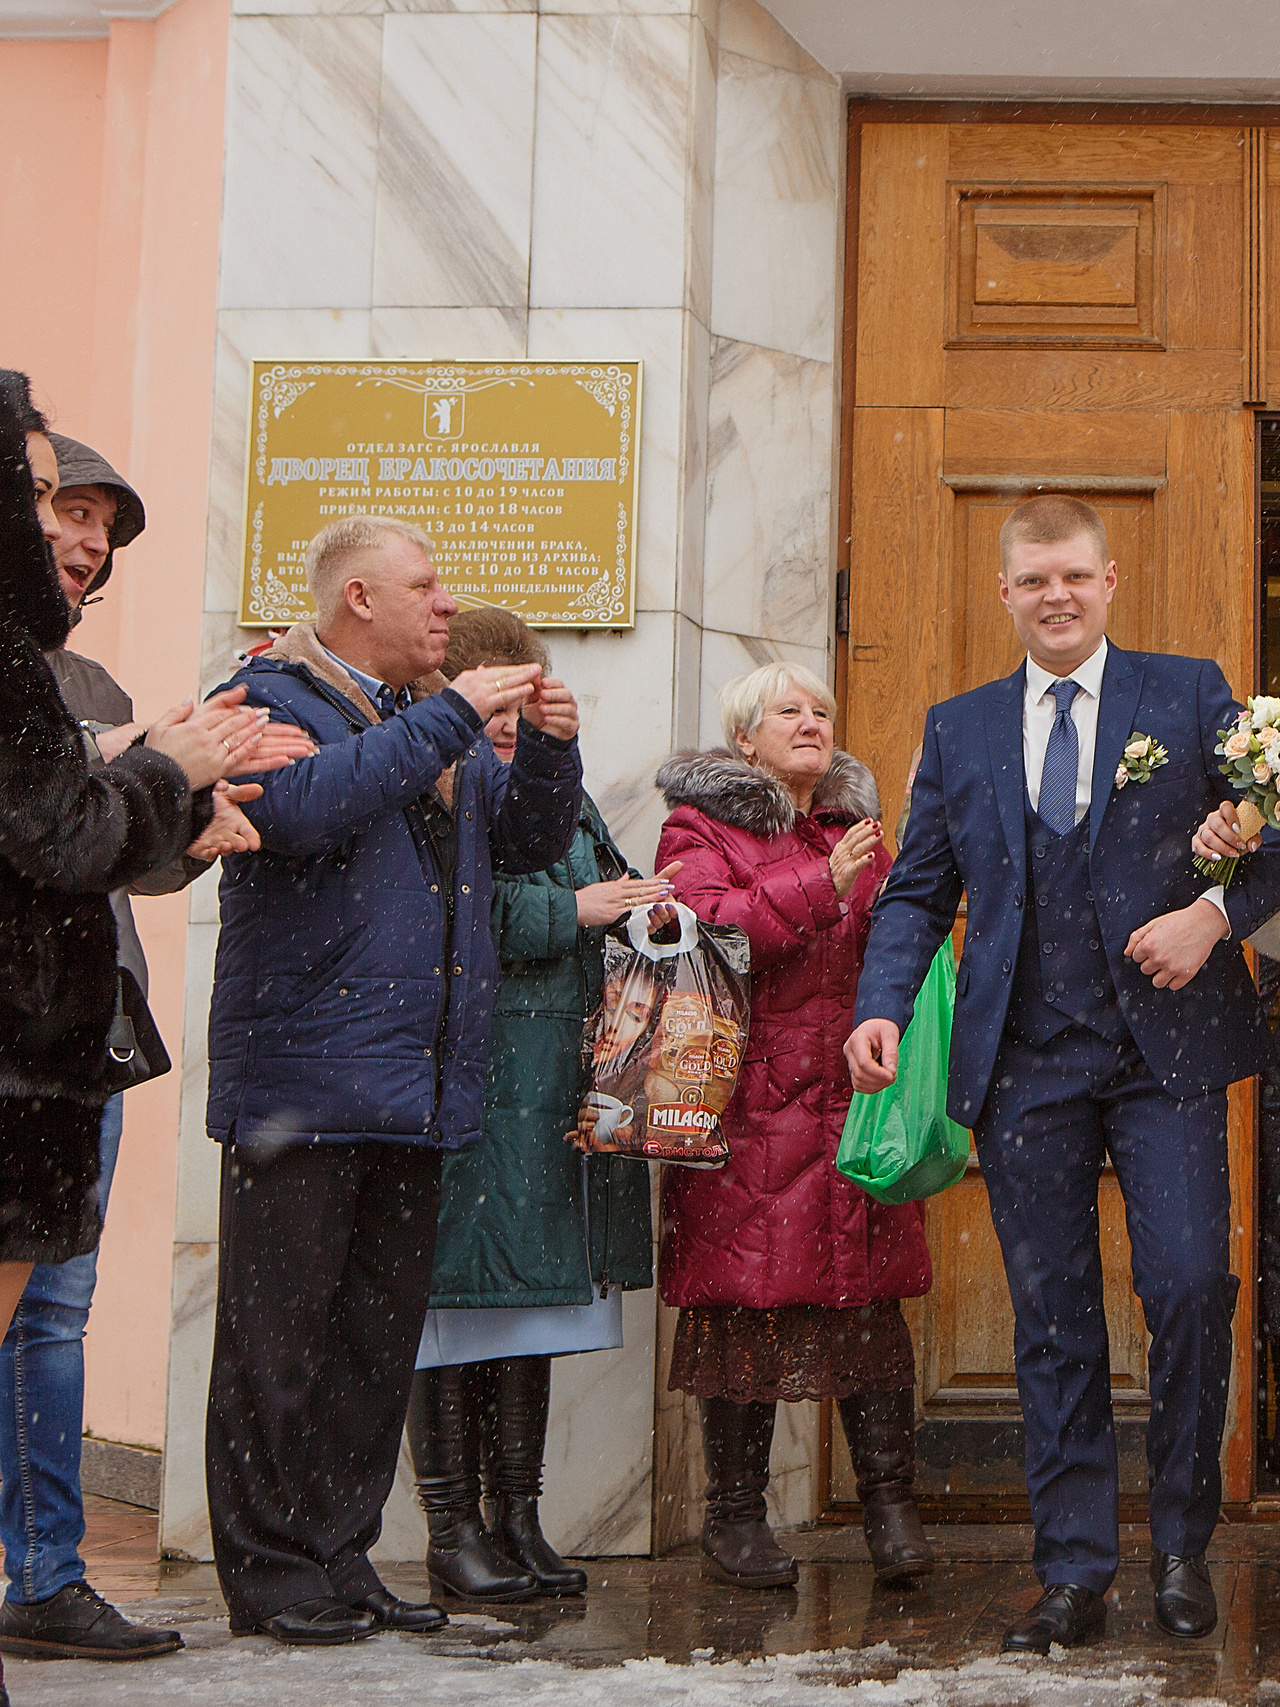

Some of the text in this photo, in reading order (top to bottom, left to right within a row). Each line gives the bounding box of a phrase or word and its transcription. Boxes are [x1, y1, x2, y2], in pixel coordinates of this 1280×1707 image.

[346, 443, 540, 455] ОТДЕЛ ЗАГС г. ЯРОСЛАВЛЯ
[267, 457, 617, 487] ДВОРЕЦ БРАКОСОЧЕТАНИЯ
[318, 487, 371, 497] РЕЖИМ
[375, 487, 440, 497] РАБОТЫ:
[454, 486, 473, 497] 10
[499, 486, 518, 497] 19
[522, 488, 565, 497] ЧАСОВ
[319, 503, 367, 515] ПРИЁМ
[370, 504, 440, 516] ГРАЖДАН:
[454, 503, 474, 515] 10
[499, 503, 518, 515] 18
[521, 505, 563, 515] ЧАСОВ
[425, 521, 445, 533] 13
[469, 521, 490, 533] 14
[492, 523, 535, 533] ЧАСОВ
[441, 540, 536, 550] ЗАКЛЮЧЕНИИ
[540, 540, 588, 552] БРАКА,
[522, 552, 539, 562] ИЗ
[543, 552, 601, 562] АРХИВА:
[478, 564, 499, 576] 10
[527, 564, 549, 576] 18
[555, 566, 600, 576] ЧАСОВ
[493, 583, 585, 595] ПОНЕДЕЛЬНИК
[652, 1108, 718, 1130] MILAGRO
